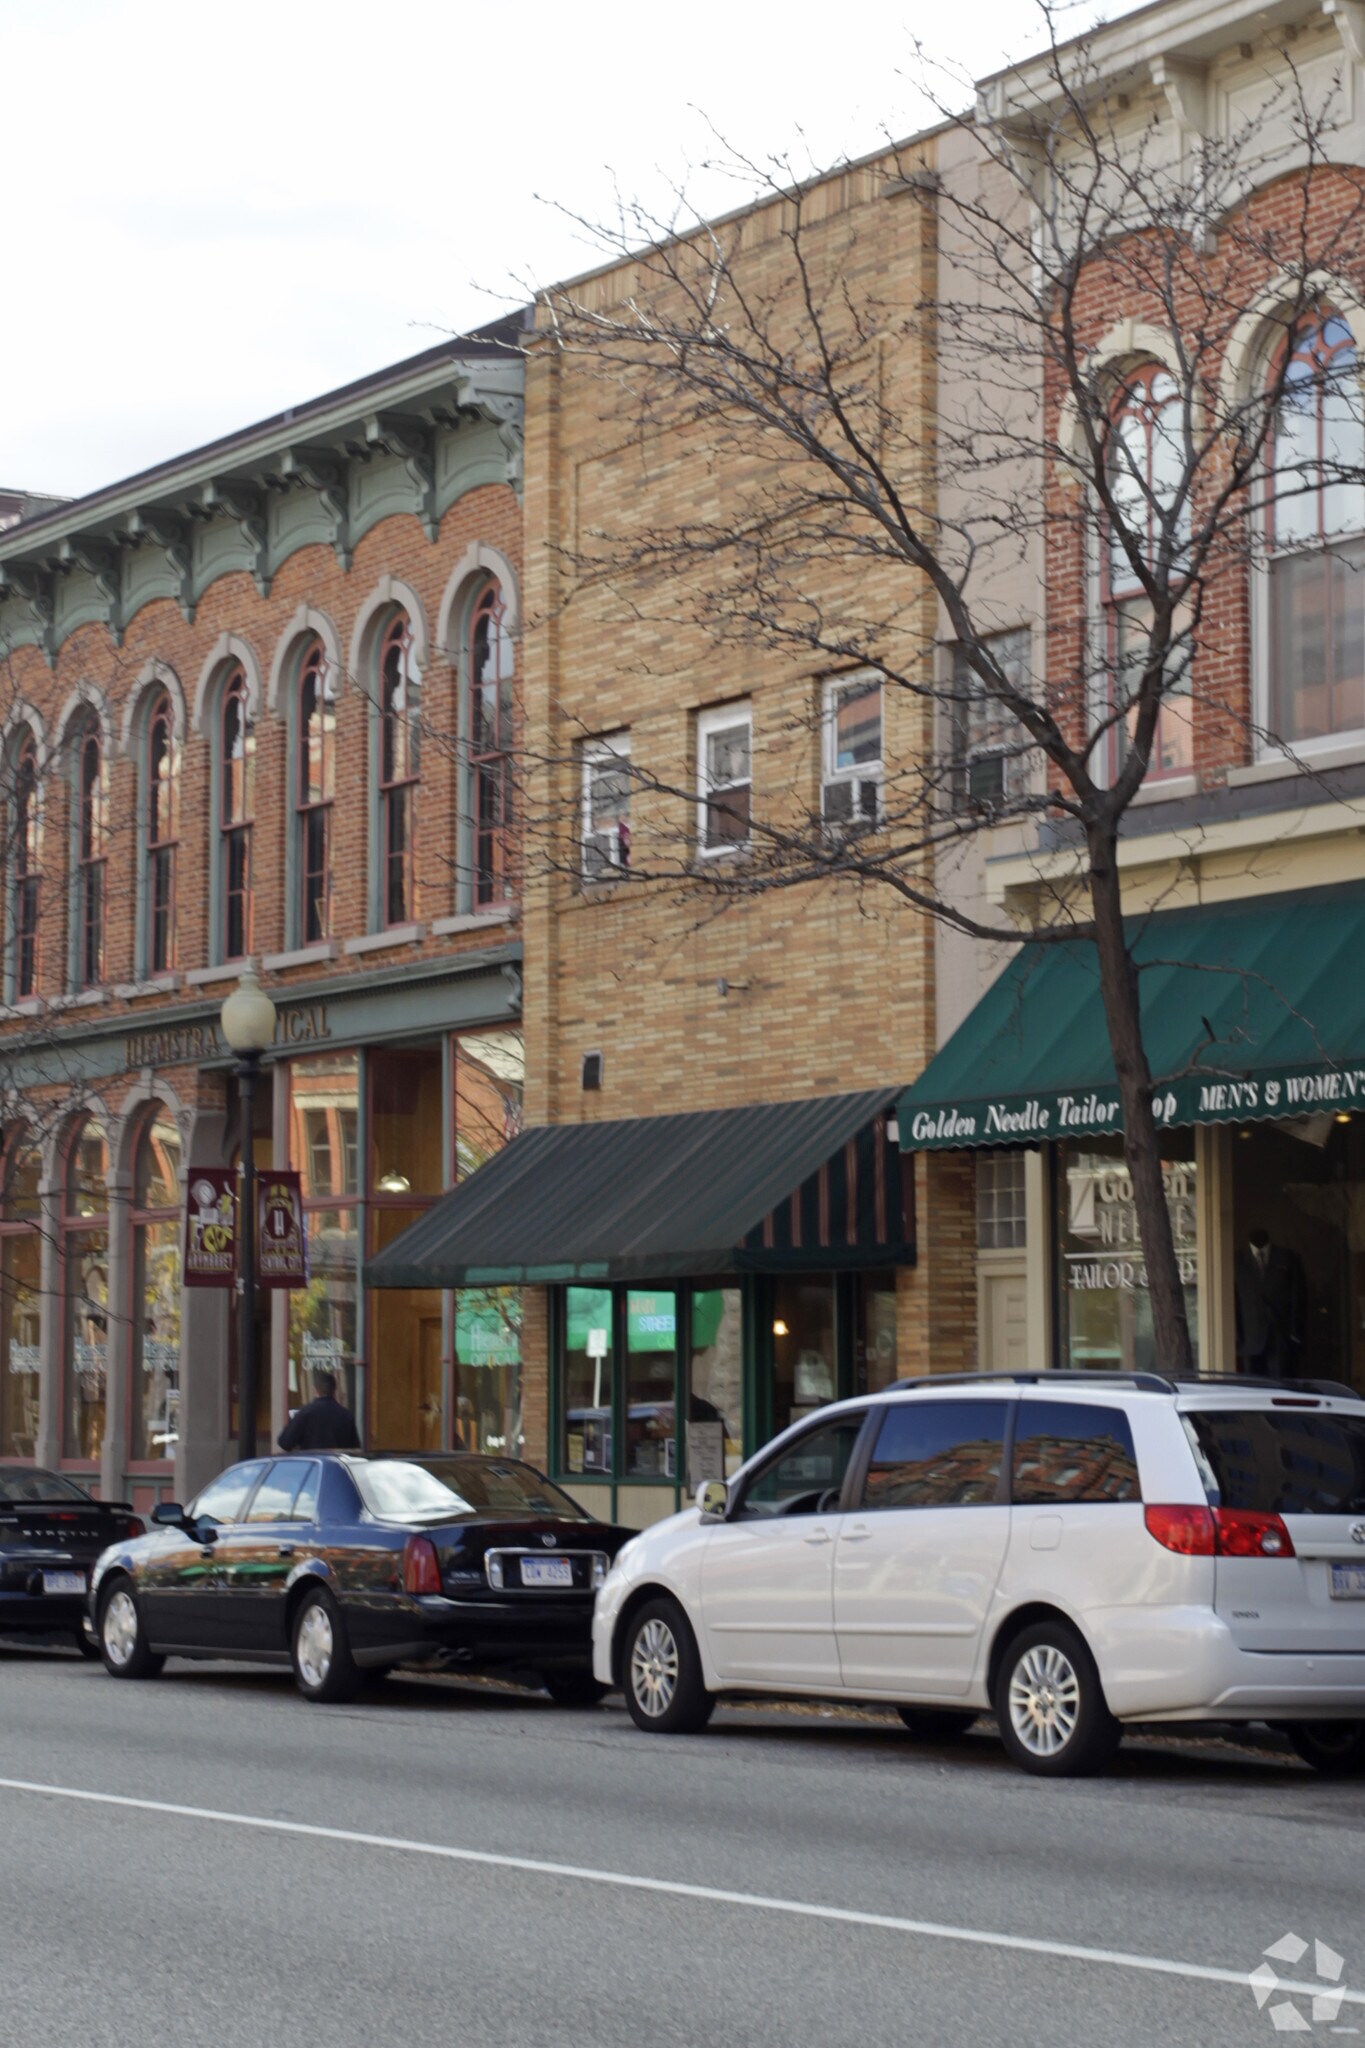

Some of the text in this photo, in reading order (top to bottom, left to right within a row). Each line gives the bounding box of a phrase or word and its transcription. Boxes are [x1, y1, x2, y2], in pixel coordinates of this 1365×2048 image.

[912, 1108, 976, 1141] Golden
[984, 1100, 1050, 1134] Needle
[1057, 1093, 1120, 1126] Tailor
[1151, 1092, 1177, 1123] op
[1199, 1081, 1259, 1111] MEN'S
[1265, 1080, 1281, 1106] &
[1101, 1203, 1187, 1245] NEEE
[1068, 1261, 1135, 1290] TAILOR
